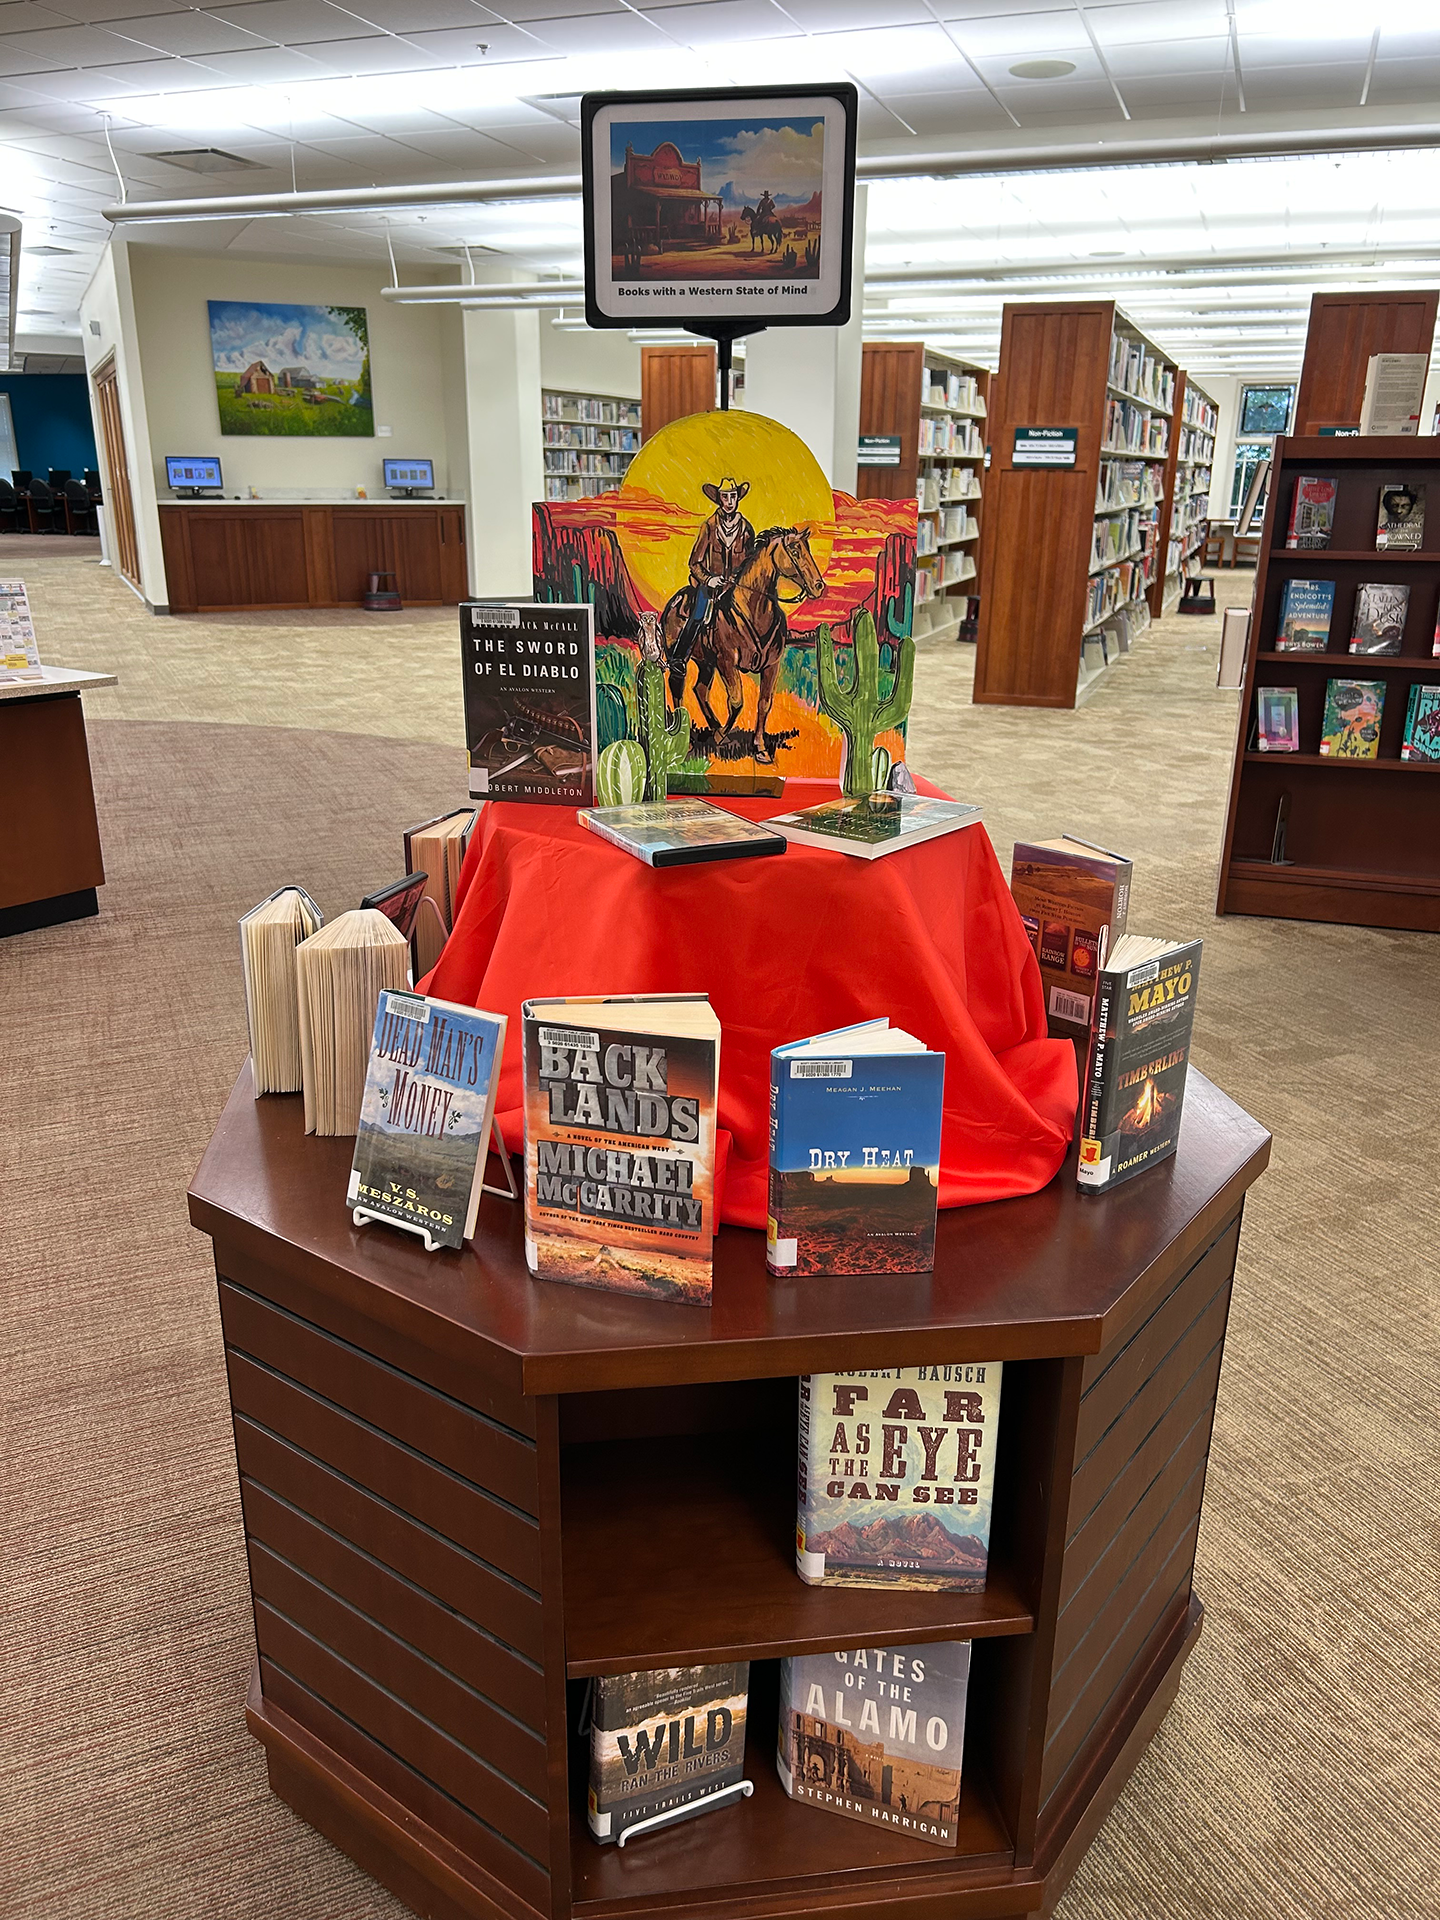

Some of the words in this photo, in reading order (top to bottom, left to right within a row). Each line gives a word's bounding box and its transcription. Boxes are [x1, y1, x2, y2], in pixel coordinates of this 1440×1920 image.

[618, 287, 650, 296] Books
[653, 287, 676, 296] with
[688, 287, 733, 295] Western
[736, 286, 764, 295] State
[767, 286, 779, 295] of
[782, 285, 808, 294] Mind
[1028, 429, 1063, 437] Non-Fiction
[473, 639, 505, 652] THE
[516, 640, 578, 655] SWORD
[475, 662, 492, 675] OF
[499, 663, 516, 676] EL
[522, 664, 579, 679] DIABLO
[488, 783, 519, 792] OBERT
[524, 785, 582, 796] MIDDLETON
[1041, 952, 1065, 965] RANGE
[1185, 959, 1193, 970] P.
[1128, 972, 1192, 1016] MAYO
[1099, 998, 1110, 1043] MATTHEW
[377, 1012, 424, 1068] DEAD
[424, 1016, 484, 1086] MAN'S
[1097, 1044, 1105, 1052] P.
[539, 1043, 667, 1092] BACK
[1094, 1053, 1105, 1078] MAYO
[1117, 1048, 1187, 1090] TIMBERLINE
[387, 1068, 454, 1141] MONEY
[550, 1081, 699, 1141] LANDS
[770, 1082, 779, 1111] DRY
[618, 1141, 650, 1150] AMERICAN
[769, 1116, 779, 1152] HEAT
[538, 1141, 693, 1194] MICHAEL
[809, 1148, 851, 1169] DRY
[862, 1147, 914, 1168] HEAT
[1079, 1168, 1094, 1176] Mayo
[1117, 1150, 1149, 1173] ROAMER
[1149, 1139, 1171, 1155] WESTERN
[358, 1183, 453, 1226] MESZAROS
[370, 1201, 403, 1216] AVALON
[406, 1213, 447, 1233] WESTERN
[593, 1219, 606, 1227] YORK
[624, 1225, 657, 1235] BESTSELLER
[674, 1233, 699, 1241] COUNTRY
[918, 1365, 986, 1383] BAUSCH
[832, 1384, 985, 1423] FAR
[830, 1422, 870, 1455] AS
[879, 1424, 983, 1482] EYE
[829, 1458, 869, 1477] THE
[826, 1481, 901, 1502] CAN
[912, 1486, 978, 1505] SEE
[889, 1560, 920, 1568] NOVEL
[834, 1649, 925, 1683] GATES
[844, 1672, 866, 1690] OF
[878, 1680, 912, 1703] THE
[632, 1701, 653, 1711] agreeable
[805, 1683, 948, 1751] ALAMO
[616, 1707, 733, 1776] WILD
[620, 1775, 648, 1793] RAN
[656, 1764, 678, 1782] THE
[685, 1750, 730, 1773] RIVERS
[622, 1808, 647, 1819] FIVE
[655, 1793, 692, 1810] TRAILS
[700, 1782, 726, 1796] WEST
[797, 1785, 862, 1813] STEPHEN
[872, 1808, 948, 1838] HARRIGAN
